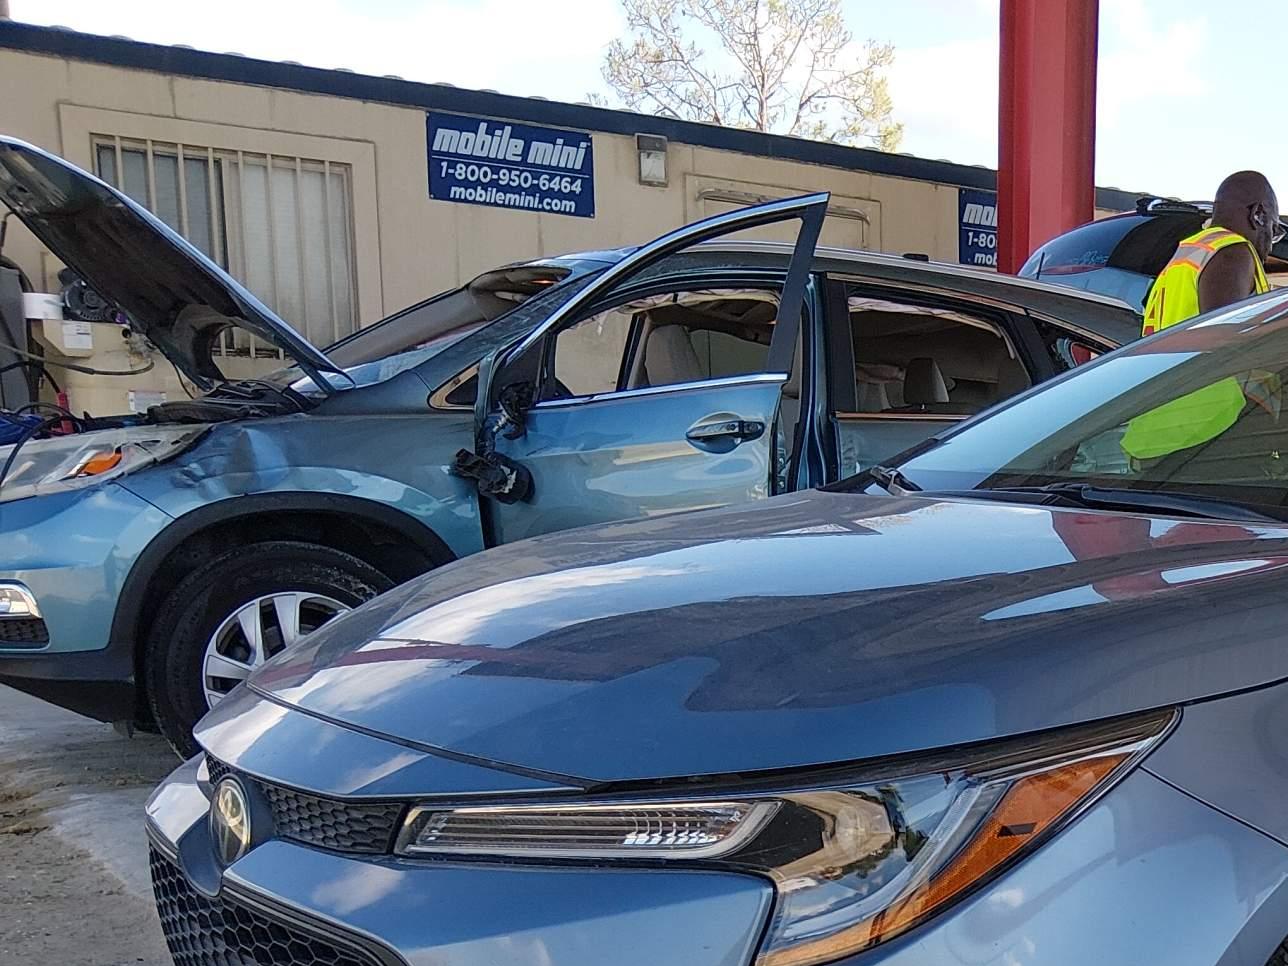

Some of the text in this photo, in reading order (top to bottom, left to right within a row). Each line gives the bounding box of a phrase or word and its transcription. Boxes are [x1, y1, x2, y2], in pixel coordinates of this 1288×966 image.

[432, 122, 588, 170] mobile mini
[440, 161, 583, 195] 1-800-950-6464
[449, 185, 576, 213] mobilemini.com
